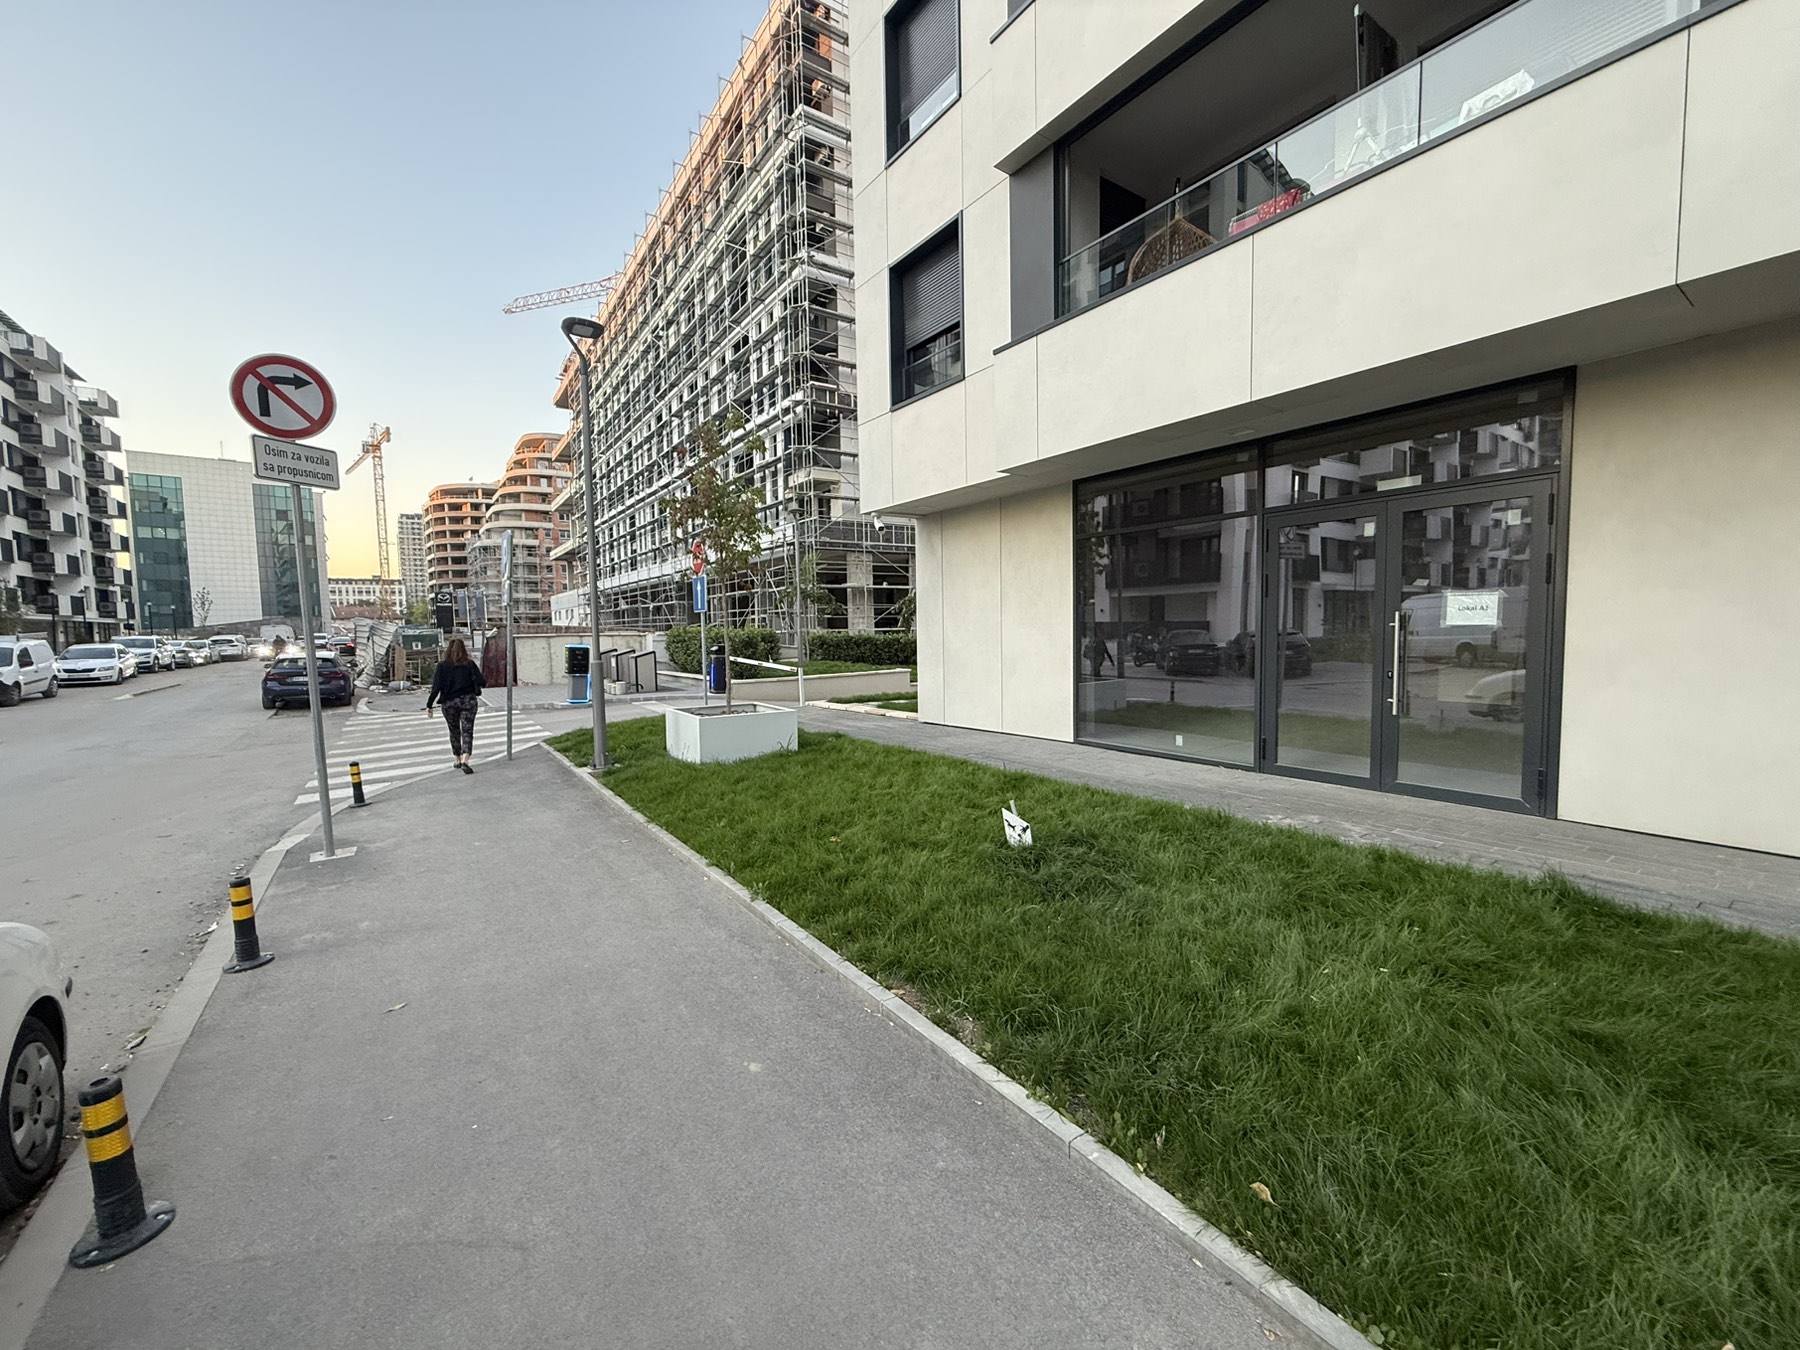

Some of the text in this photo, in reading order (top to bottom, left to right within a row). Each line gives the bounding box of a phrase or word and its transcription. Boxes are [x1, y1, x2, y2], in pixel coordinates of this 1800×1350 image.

[264, 443, 330, 466] Osim za vozila
[263, 462, 334, 482] sa propusnicom
